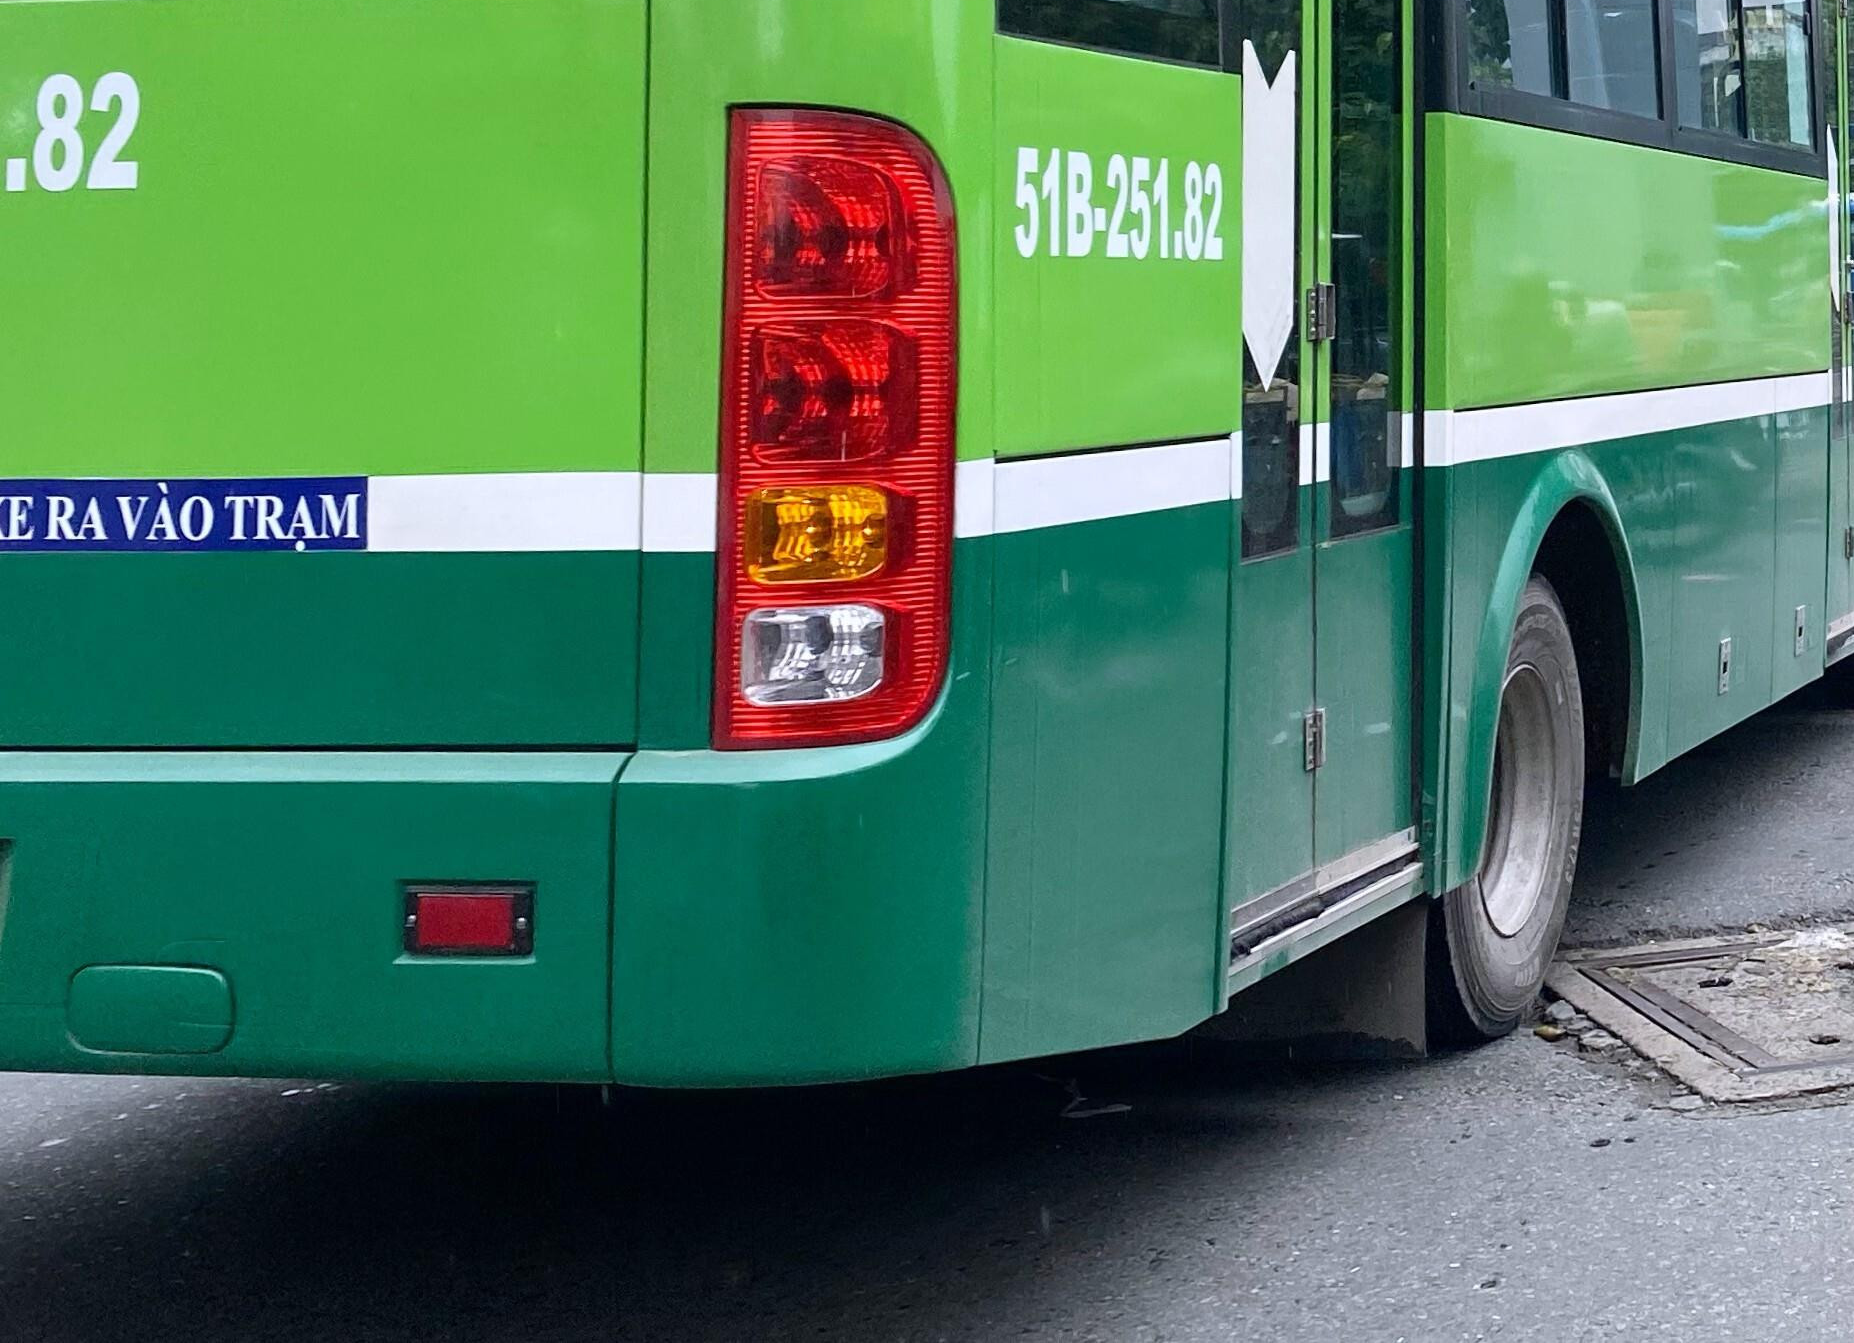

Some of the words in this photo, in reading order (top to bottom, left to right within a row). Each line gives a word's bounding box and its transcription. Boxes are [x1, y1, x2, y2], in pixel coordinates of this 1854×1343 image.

[1013, 145, 1224, 261] 51B-251.82
[45, 495, 109, 542] RA
[116, 482, 215, 542] VÀO
[224, 492, 362, 553] TRẠM
